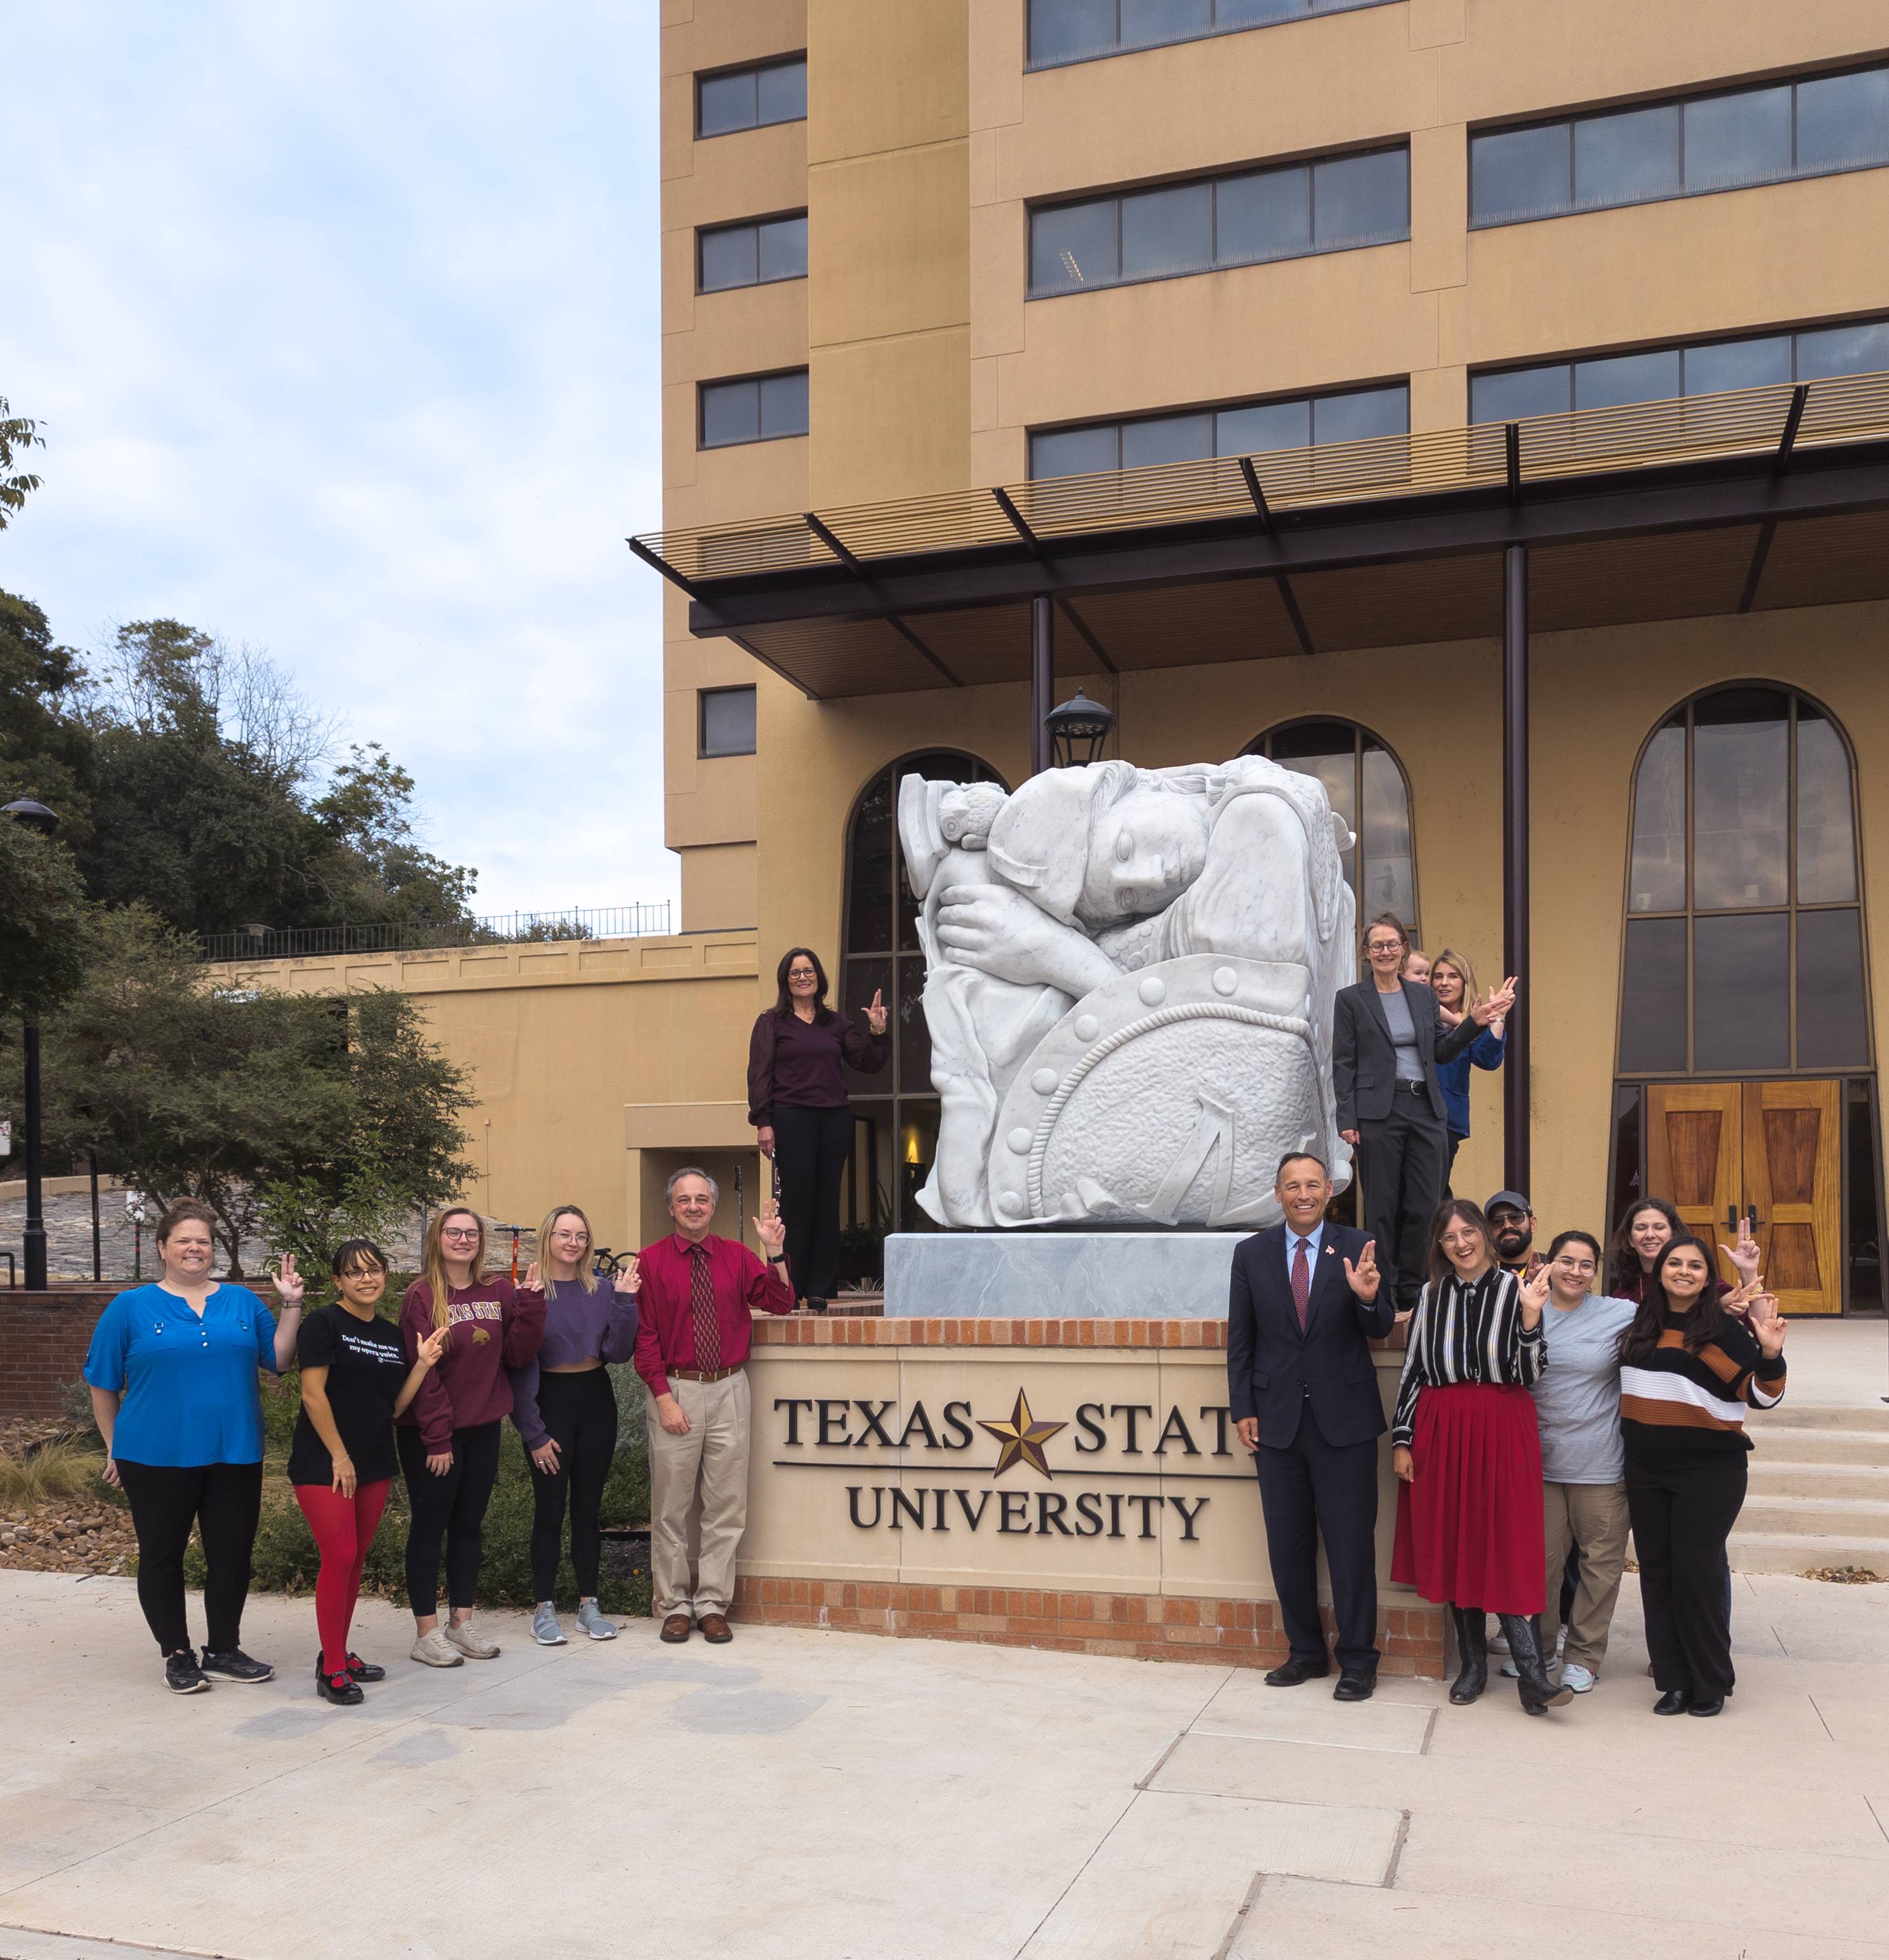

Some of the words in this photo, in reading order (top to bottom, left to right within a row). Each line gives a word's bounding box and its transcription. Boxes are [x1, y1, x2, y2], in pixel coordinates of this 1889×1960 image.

[472, 1301, 502, 1321] STAT
[342, 1334, 360, 1344] Don't
[360, 1340, 377, 1348] make
[349, 1345, 360, 1353] my
[361, 1348, 379, 1357] opera
[379, 1351, 399, 1359] voice.
[773, 1398, 974, 1450] TEXAS
[1074, 1403, 1259, 1456] STAT
[845, 1486, 1211, 1540] UNIVERSITY
